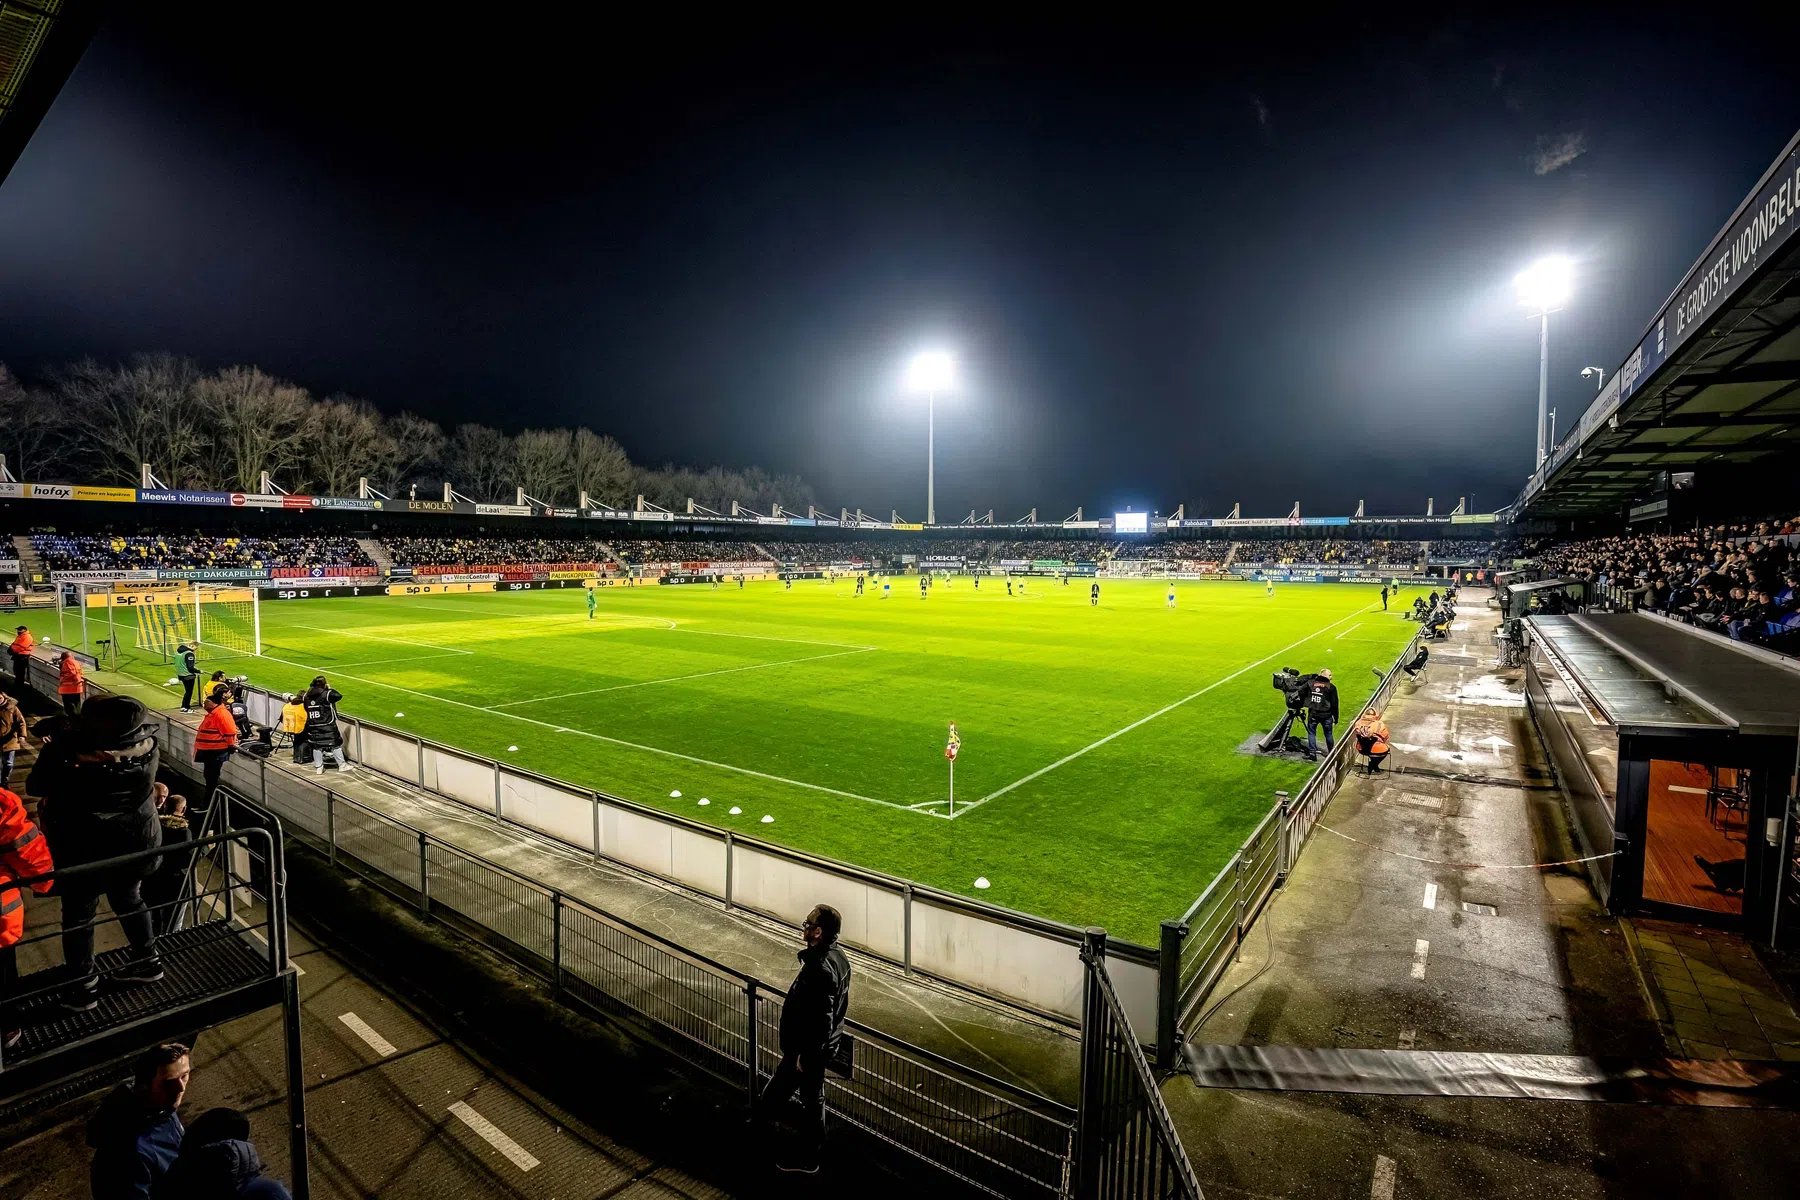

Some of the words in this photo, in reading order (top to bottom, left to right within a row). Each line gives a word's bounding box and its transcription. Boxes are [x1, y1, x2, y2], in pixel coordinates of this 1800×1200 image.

[1676, 301, 1686, 336] DE
[1686, 250, 1730, 324] GROOTSTE
[33, 486, 70, 498] hofax
[141, 492, 176, 501] Meewis
[179, 494, 226, 503] Notarissen
[408, 501, 421, 509] DE
[422, 502, 454, 511] MOLEN
[270, 568, 310, 578] ARNO
[324, 567, 378, 577] DUNGEN
[416, 566, 465, 574] EEKMANS
[468, 565, 523, 574] HEFTRUCKS
[523, 563, 575, 573] AFVALCONTAINER
[159, 571, 202, 579] PERFECT
[203, 570, 267, 578] DAKKAPELLEN
[1311, 695, 1322, 703] HB
[309, 710, 321, 719] HB
